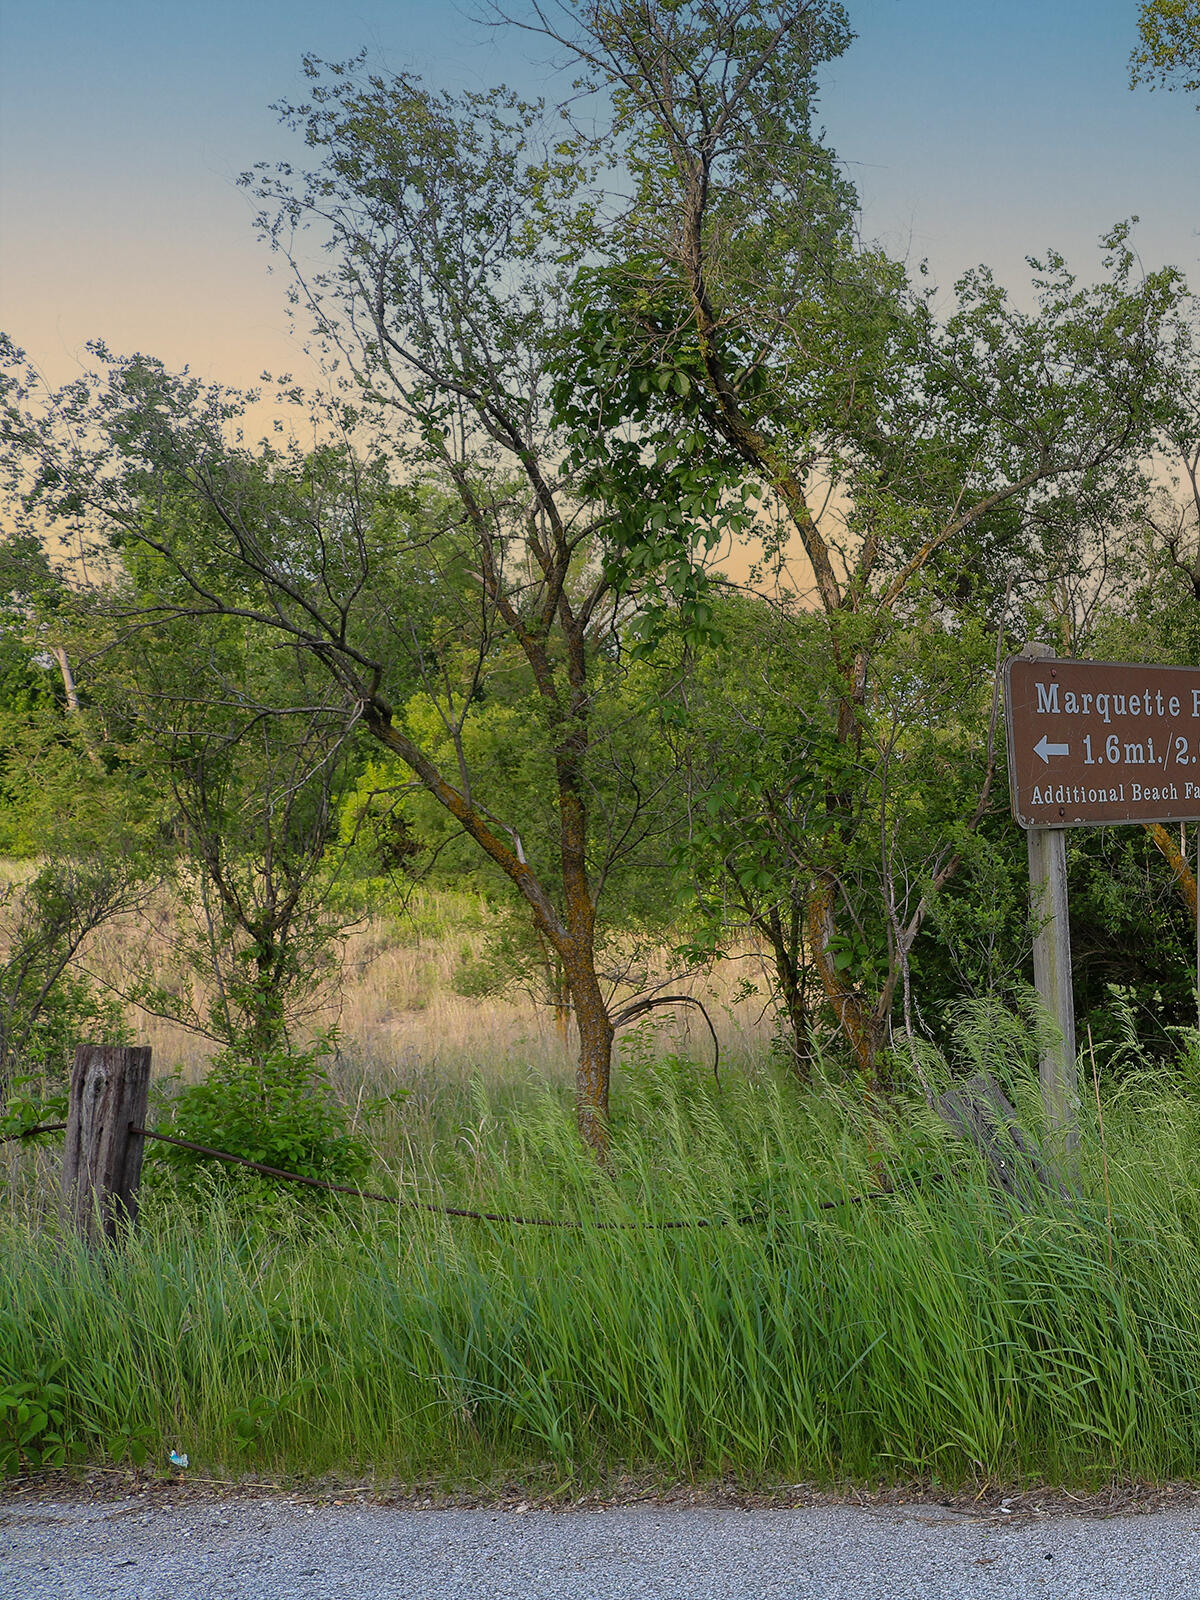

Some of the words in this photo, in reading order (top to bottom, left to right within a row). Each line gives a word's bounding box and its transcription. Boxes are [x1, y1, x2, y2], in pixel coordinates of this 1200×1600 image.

[1035, 683, 1180, 723] Marquette
[1031, 784, 1125, 805] Additional
[1131, 783, 1178, 801] Beach
